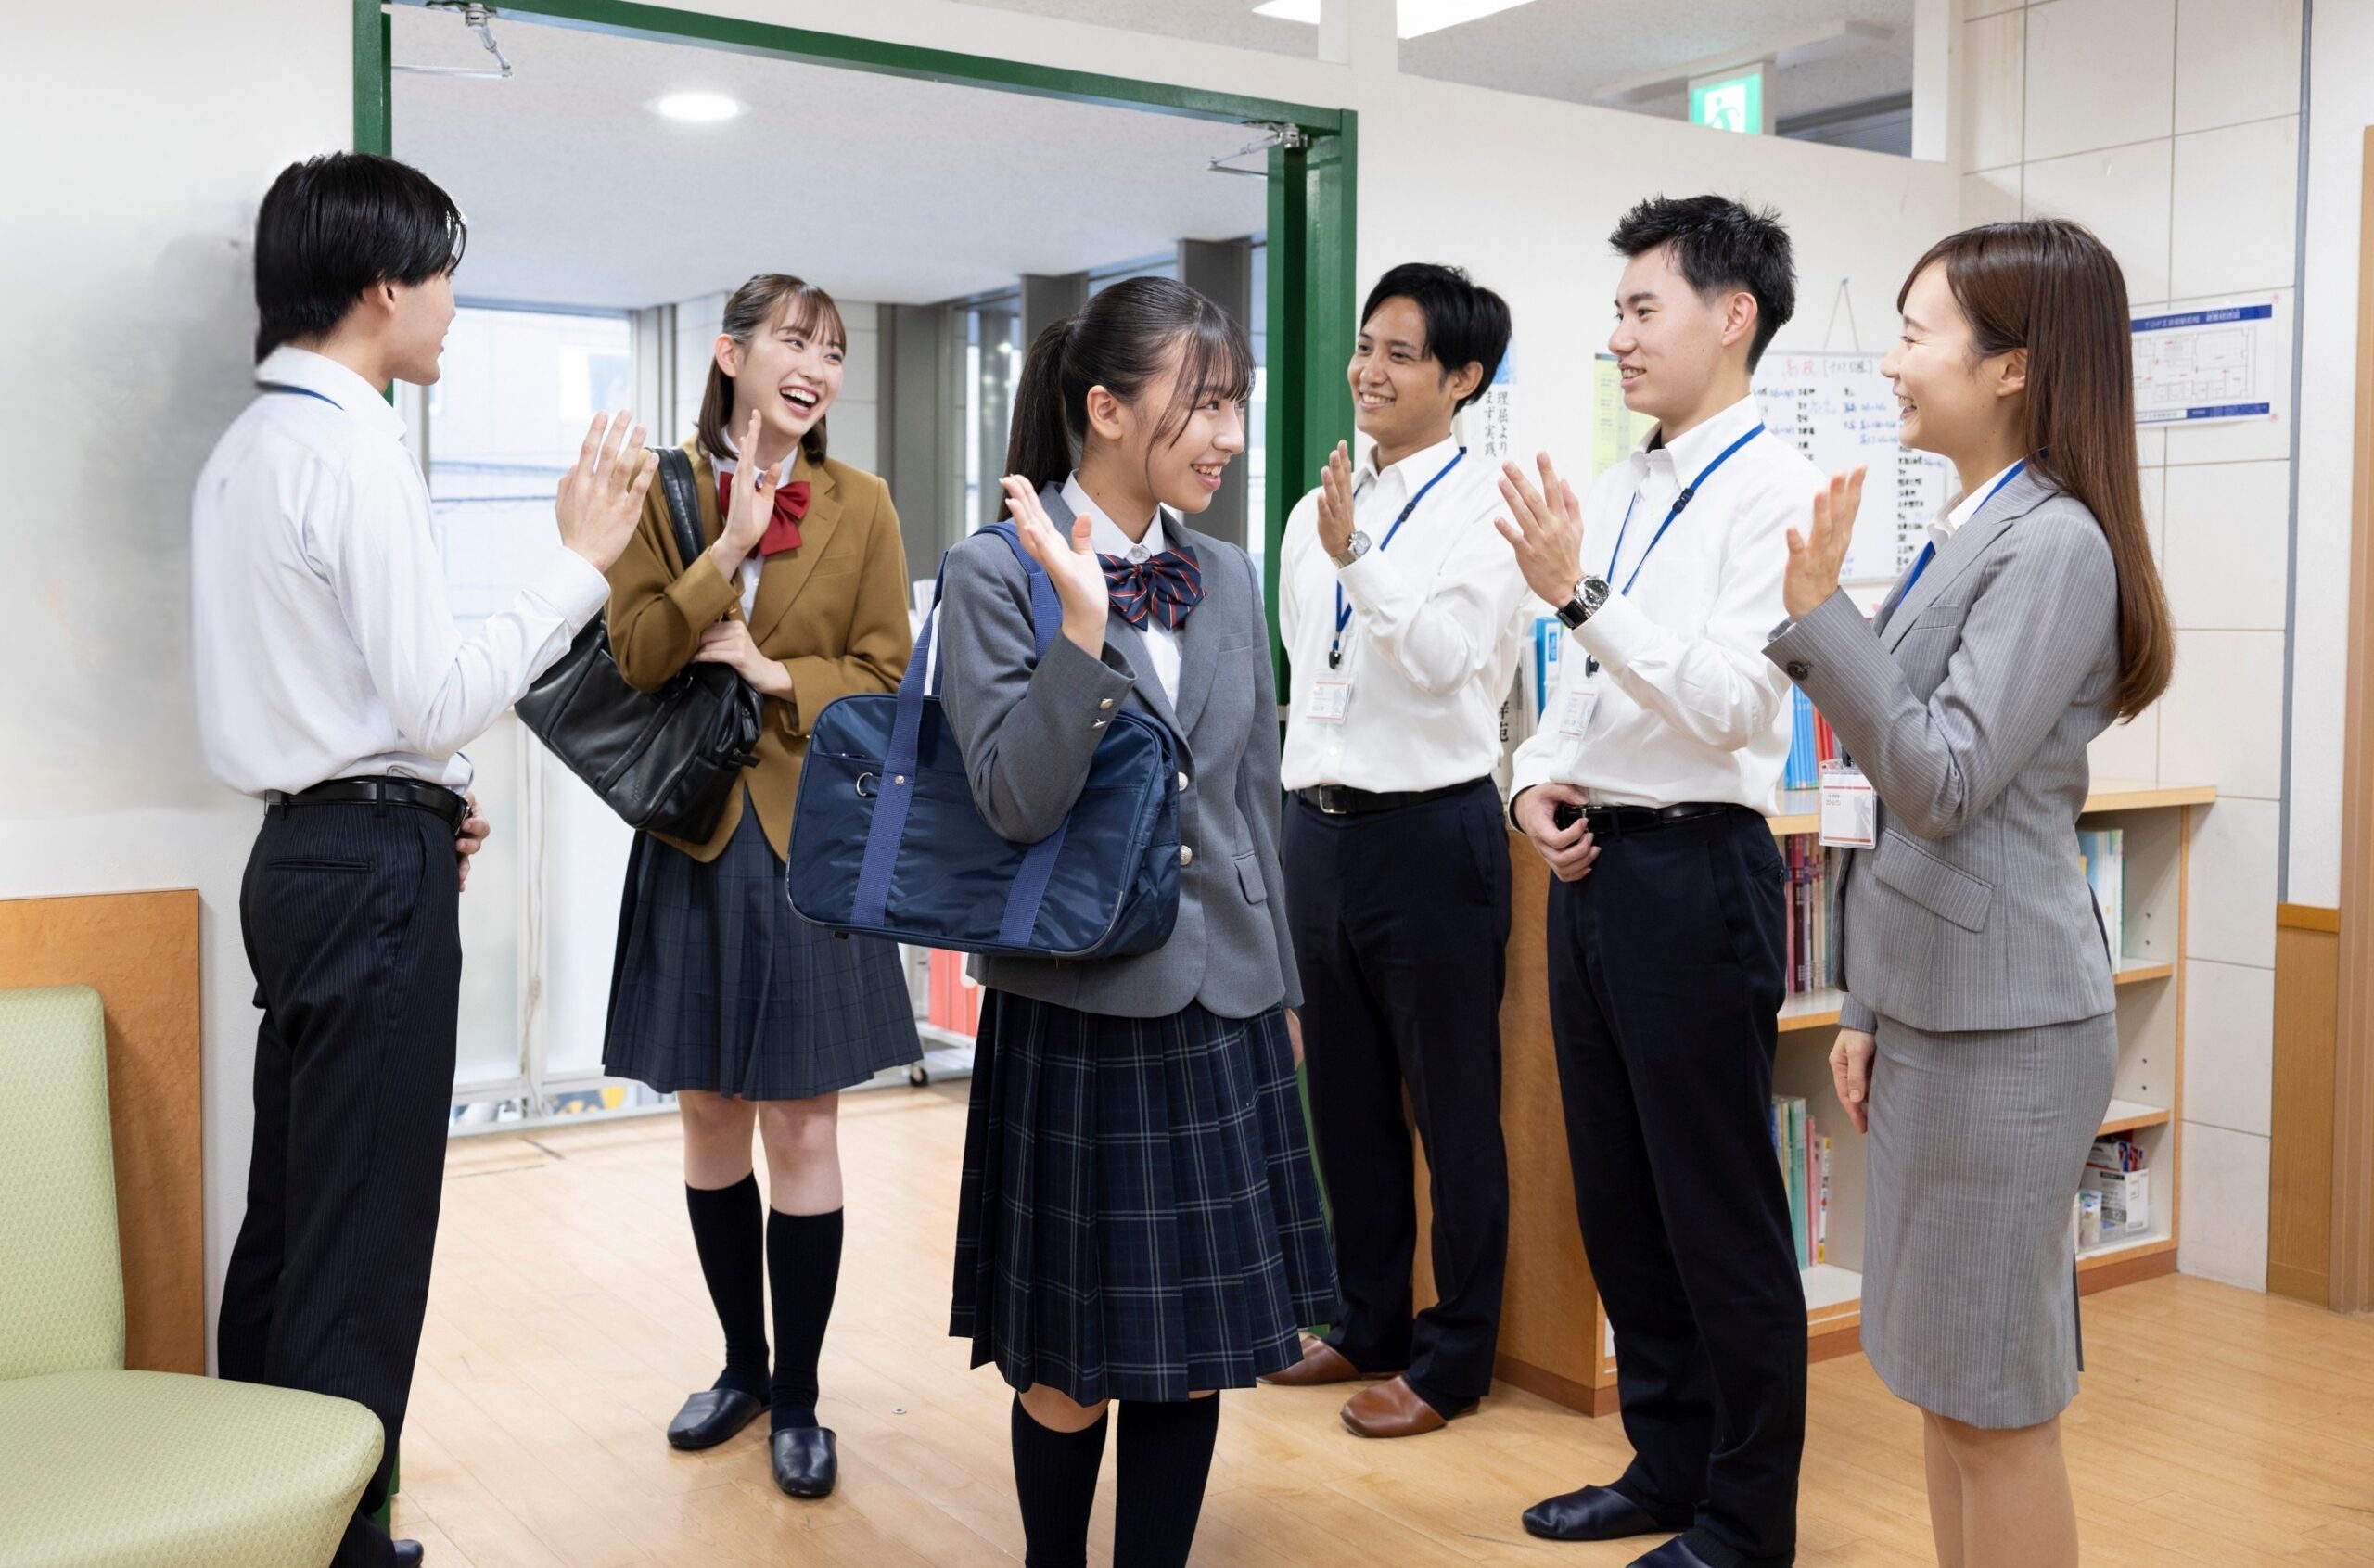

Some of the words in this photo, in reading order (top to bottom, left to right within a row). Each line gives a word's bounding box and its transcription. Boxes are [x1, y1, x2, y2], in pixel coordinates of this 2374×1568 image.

[1484, 390, 1497, 457] まず実践
[1497, 391, 1510, 455] 理屈より
